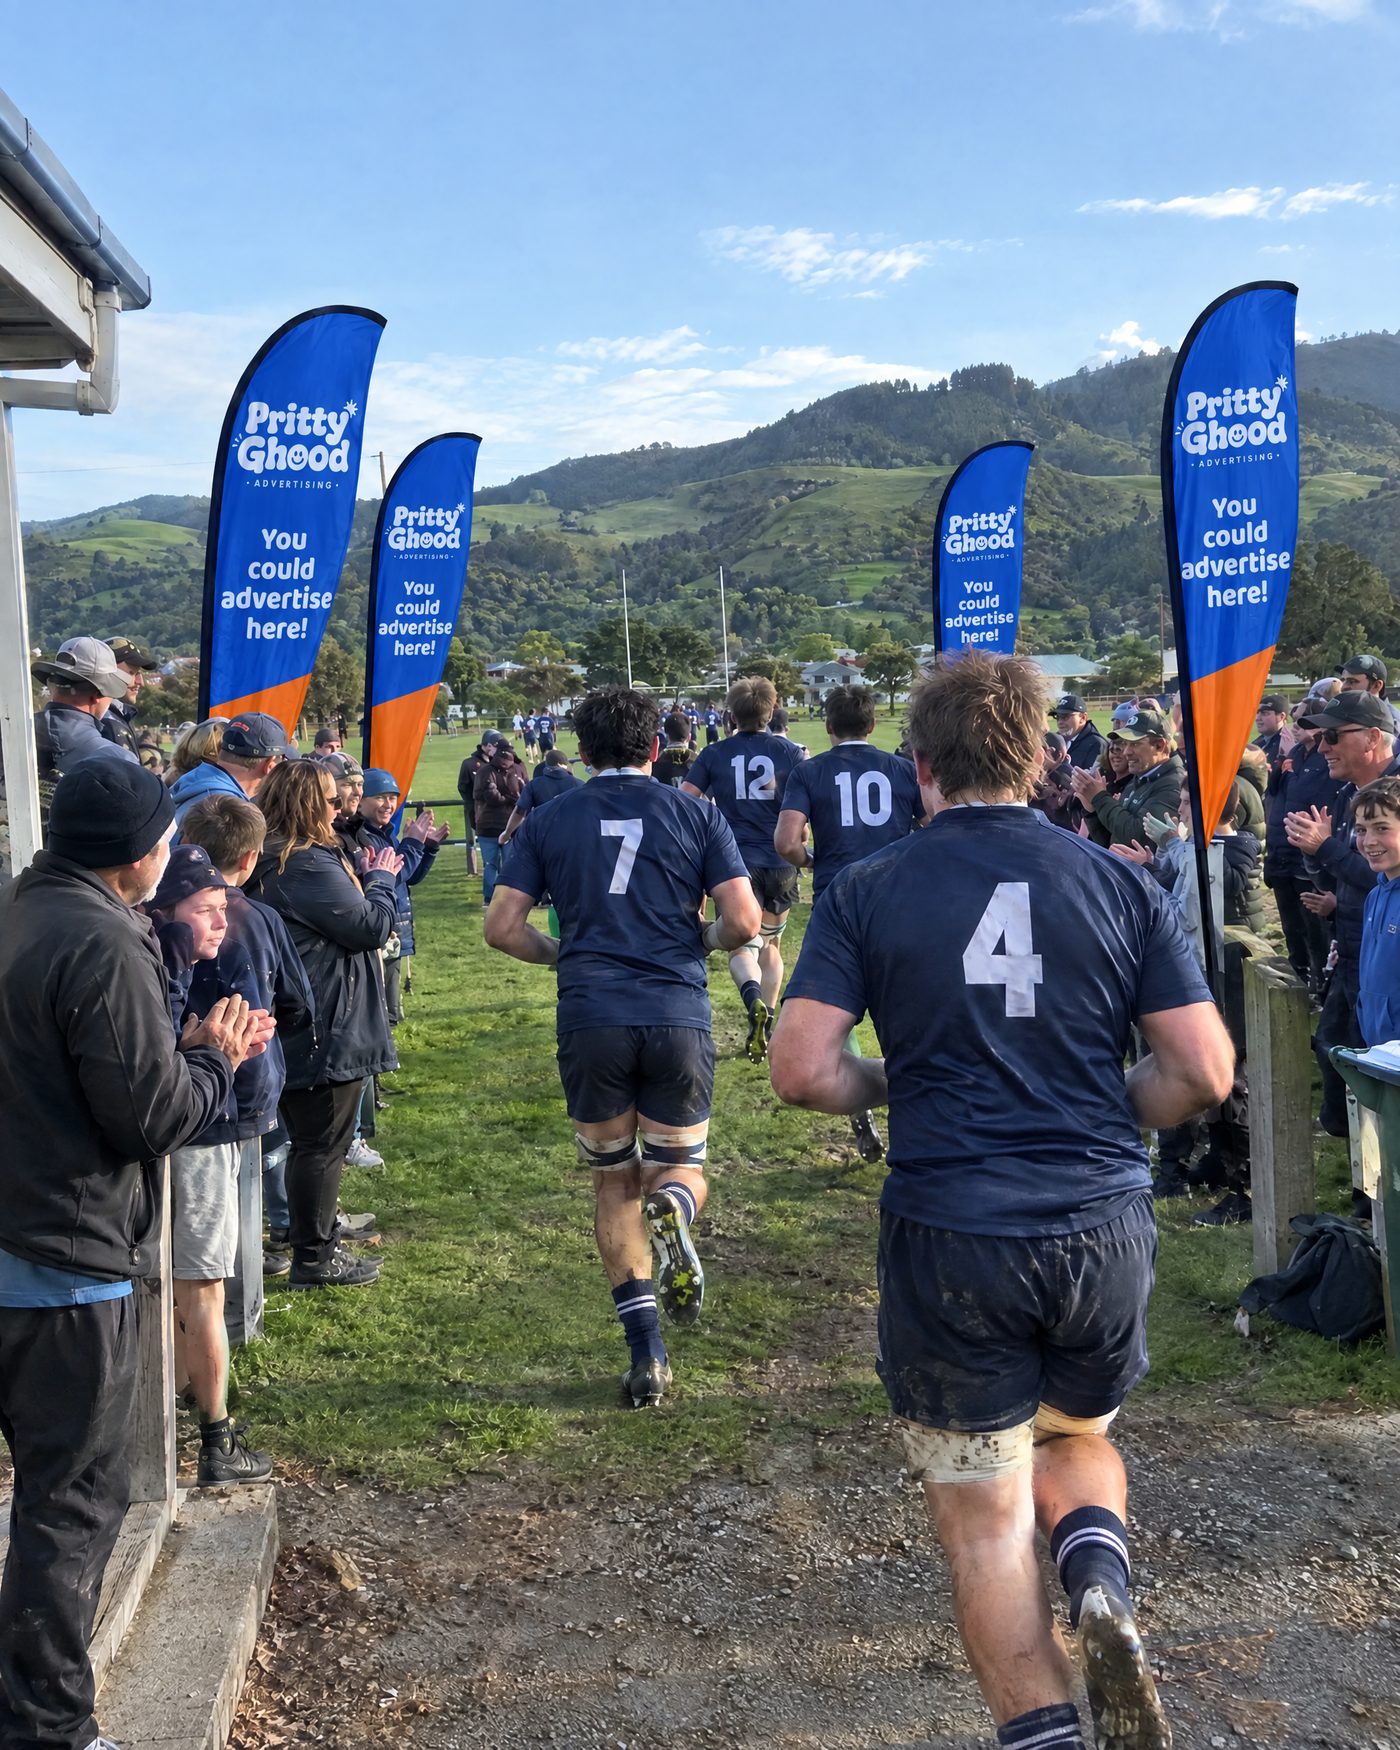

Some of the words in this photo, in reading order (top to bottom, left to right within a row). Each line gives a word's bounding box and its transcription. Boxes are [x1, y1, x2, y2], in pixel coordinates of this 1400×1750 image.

[1186, 386, 1282, 421] Pritty
[245, 401, 349, 445] Pritty
[1181, 411, 1288, 456] Ghood
[237, 435, 350, 474] Ghood
[1198, 452, 1273, 468] ADVERTISING
[254, 479, 332, 490] ADVERTISING
[393, 505, 460, 533] Pritty
[1211, 497, 1257, 519] You
[948, 512, 1012, 534] Pritty
[1203, 520, 1268, 549] could
[261, 528, 307, 551] You
[388, 526, 461, 551] Ghood
[945, 528, 1015, 555] Ghood
[248, 557, 315, 580] could
[956, 553, 1005, 563] ADVERTISING
[1181, 547, 1291, 580] advertise
[220, 586, 333, 610] advertise
[403, 581, 435, 596] You
[963, 581, 993, 594] You
[1207, 580, 1268, 608] here!
[395, 599, 441, 616] could
[958, 594, 1000, 611] could
[246, 617, 308, 640] here!
[378, 620, 453, 636] advertise
[945, 611, 1014, 628] advertise
[960, 629, 999, 643] here!
[394, 640, 436, 656] here!
[731, 754, 776, 800] 12
[834, 770, 892, 827] 10
[600, 818, 644, 895] 7
[962, 882, 1043, 1018] 4
